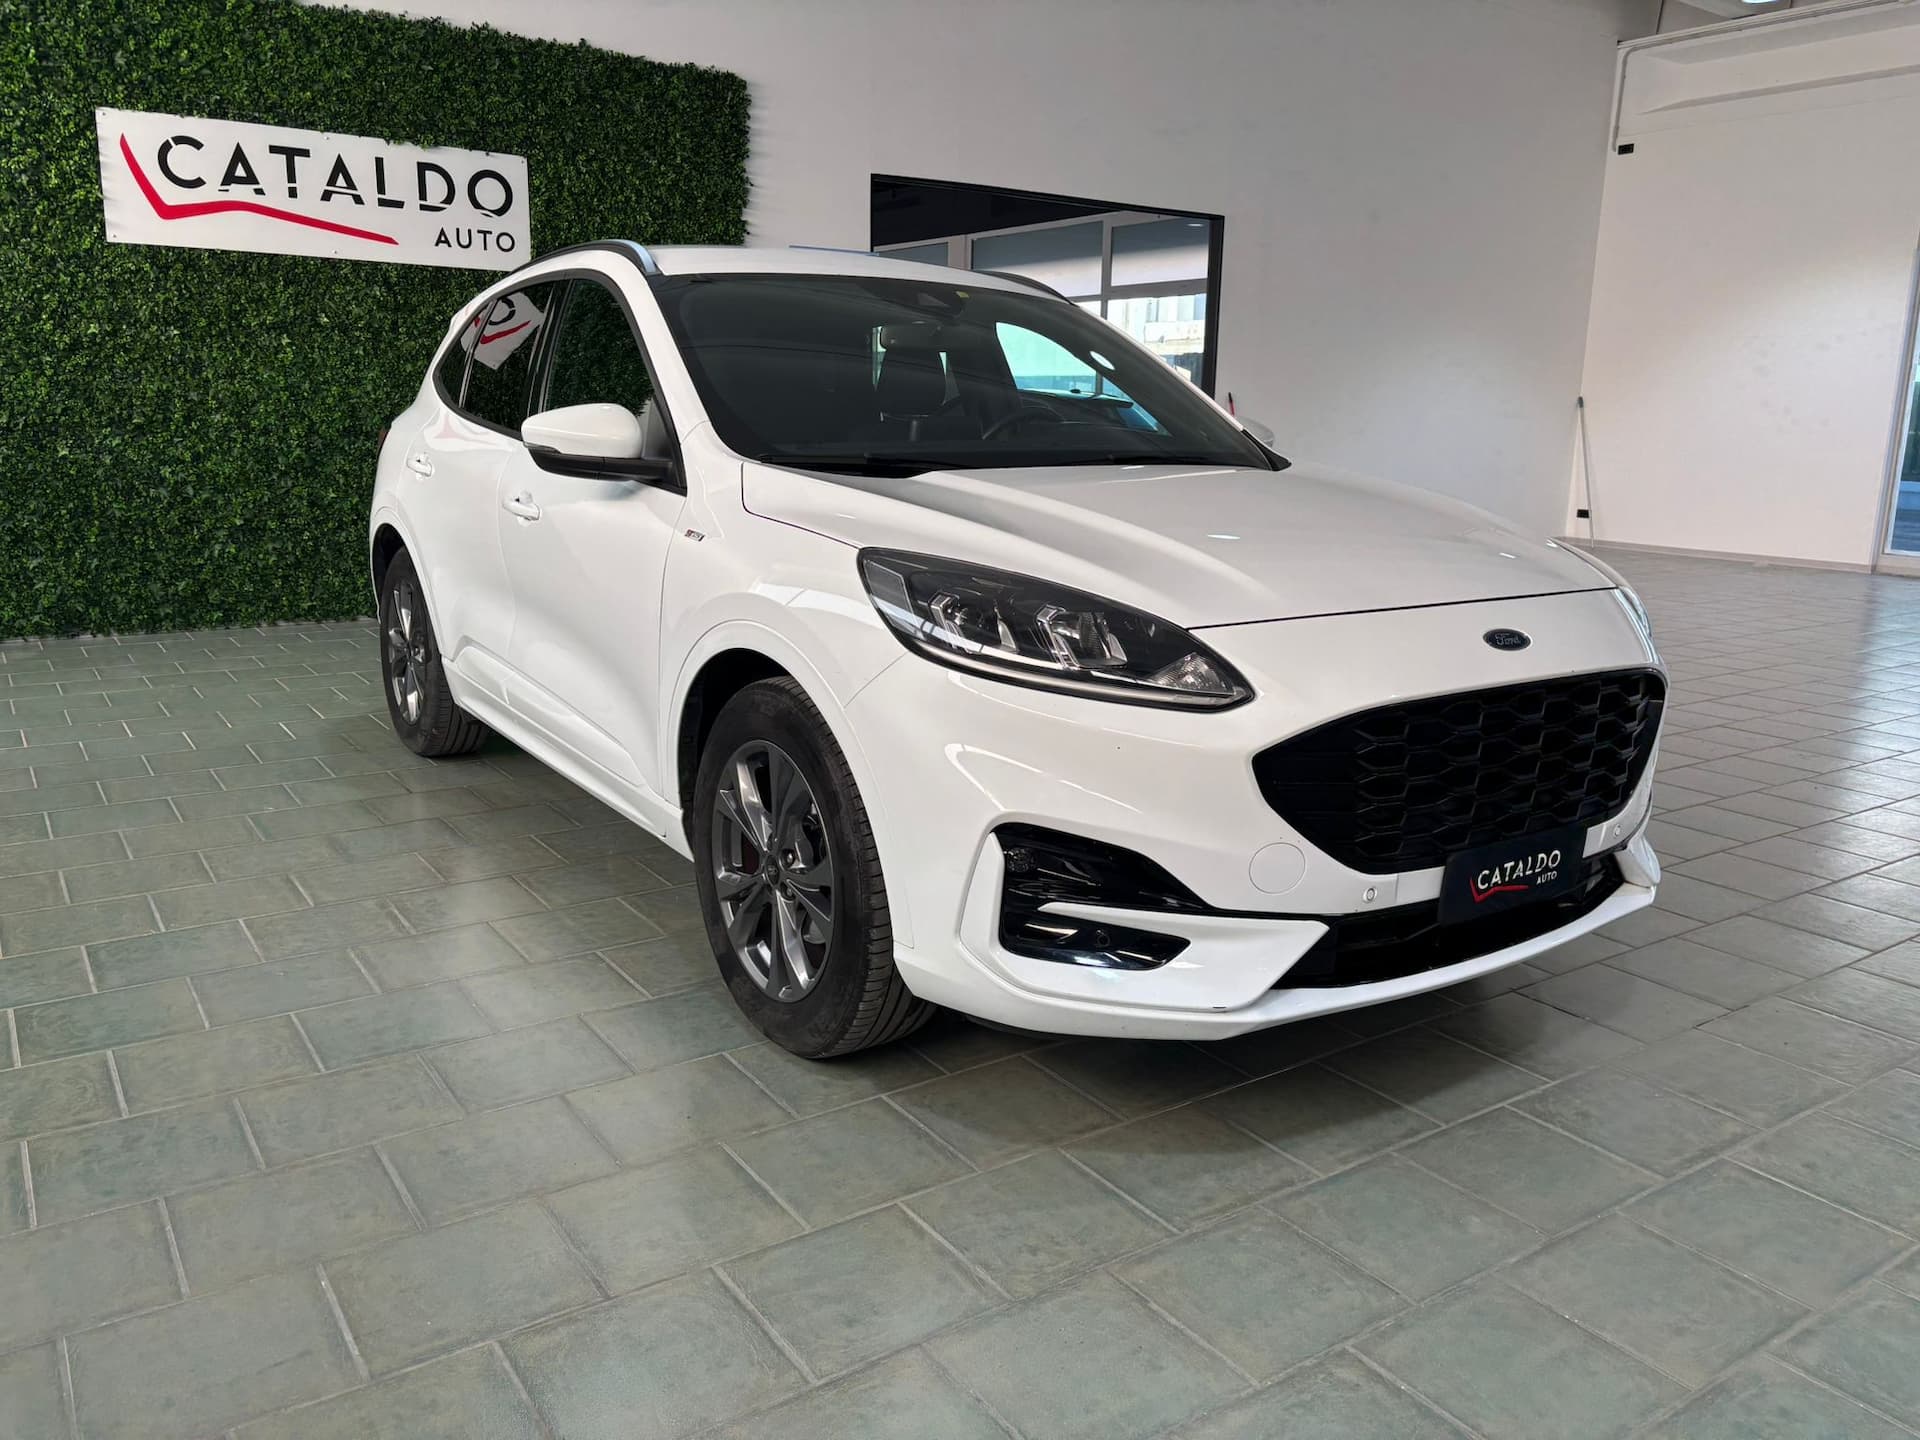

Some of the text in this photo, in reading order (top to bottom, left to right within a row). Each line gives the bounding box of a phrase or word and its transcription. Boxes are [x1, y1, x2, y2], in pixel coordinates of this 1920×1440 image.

[156, 135, 513, 218] CATALDO
[434, 226, 516, 252] AUTO
[1477, 849, 1561, 889] CATALDO
[1536, 871, 1557, 885] AUTO
